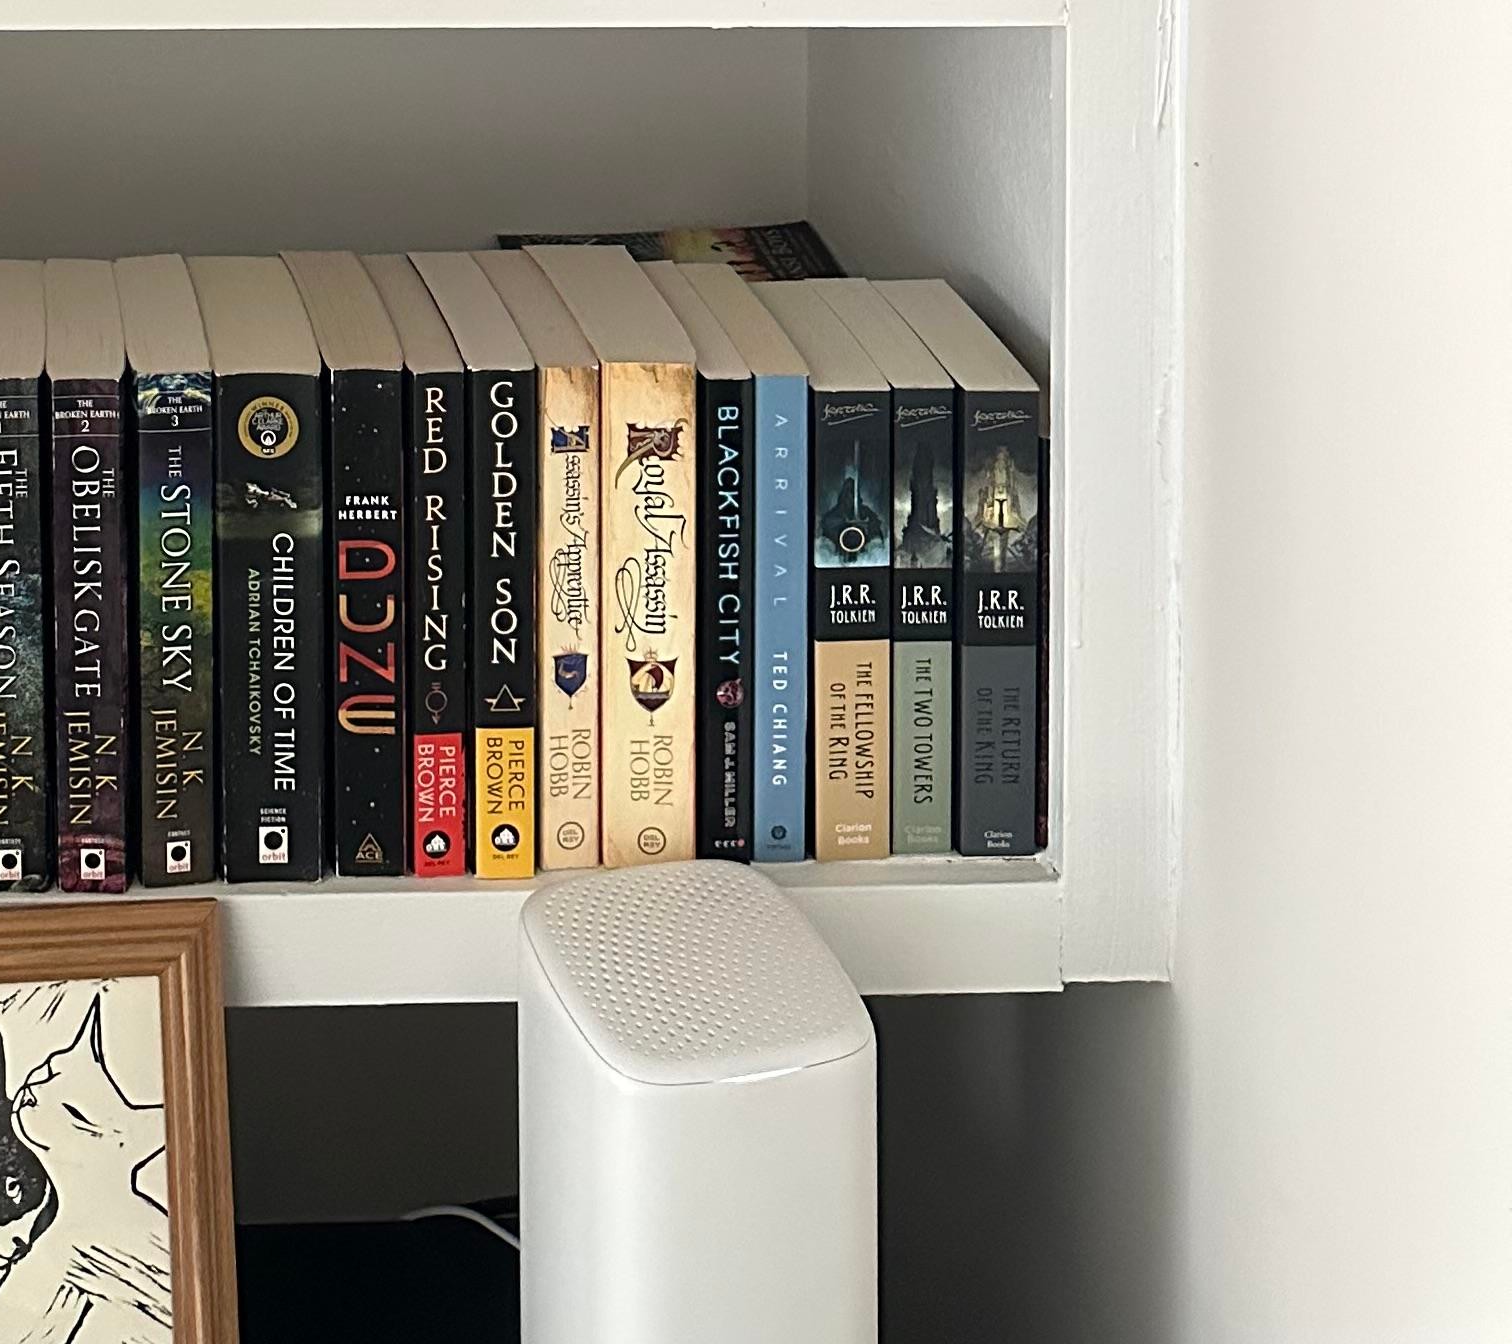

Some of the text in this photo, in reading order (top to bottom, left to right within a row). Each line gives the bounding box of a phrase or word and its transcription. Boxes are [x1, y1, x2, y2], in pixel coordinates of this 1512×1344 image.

[338, 509, 398, 520] HERBERT
[345, 495, 389, 507] FRANK
[423, 387, 447, 673] RED RISING
[490, 381, 518, 665] GOLDEN SON
[716, 406, 740, 665] BLACKFISH CITY
[773, 414, 788, 606] ARRIVAL
[72, 446, 103, 698] OBELISK GATE
[160, 483, 192, 693] STONE SKY
[829, 585, 876, 606] J.R.R.
[830, 610, 876, 623] TOLKIEN
[272, 532, 295, 791] CHILDREN OF TIME
[337, 539, 396, 735] DUNE
[150, 709, 178, 821] JEMISIN
[487, 737, 502, 814] BROWN
[507, 739, 525, 811] PIERCE
[355, 850, 383, 861] ACE
[836, 823, 872, 833] Clarion
[838, 834, 869, 844] Books
